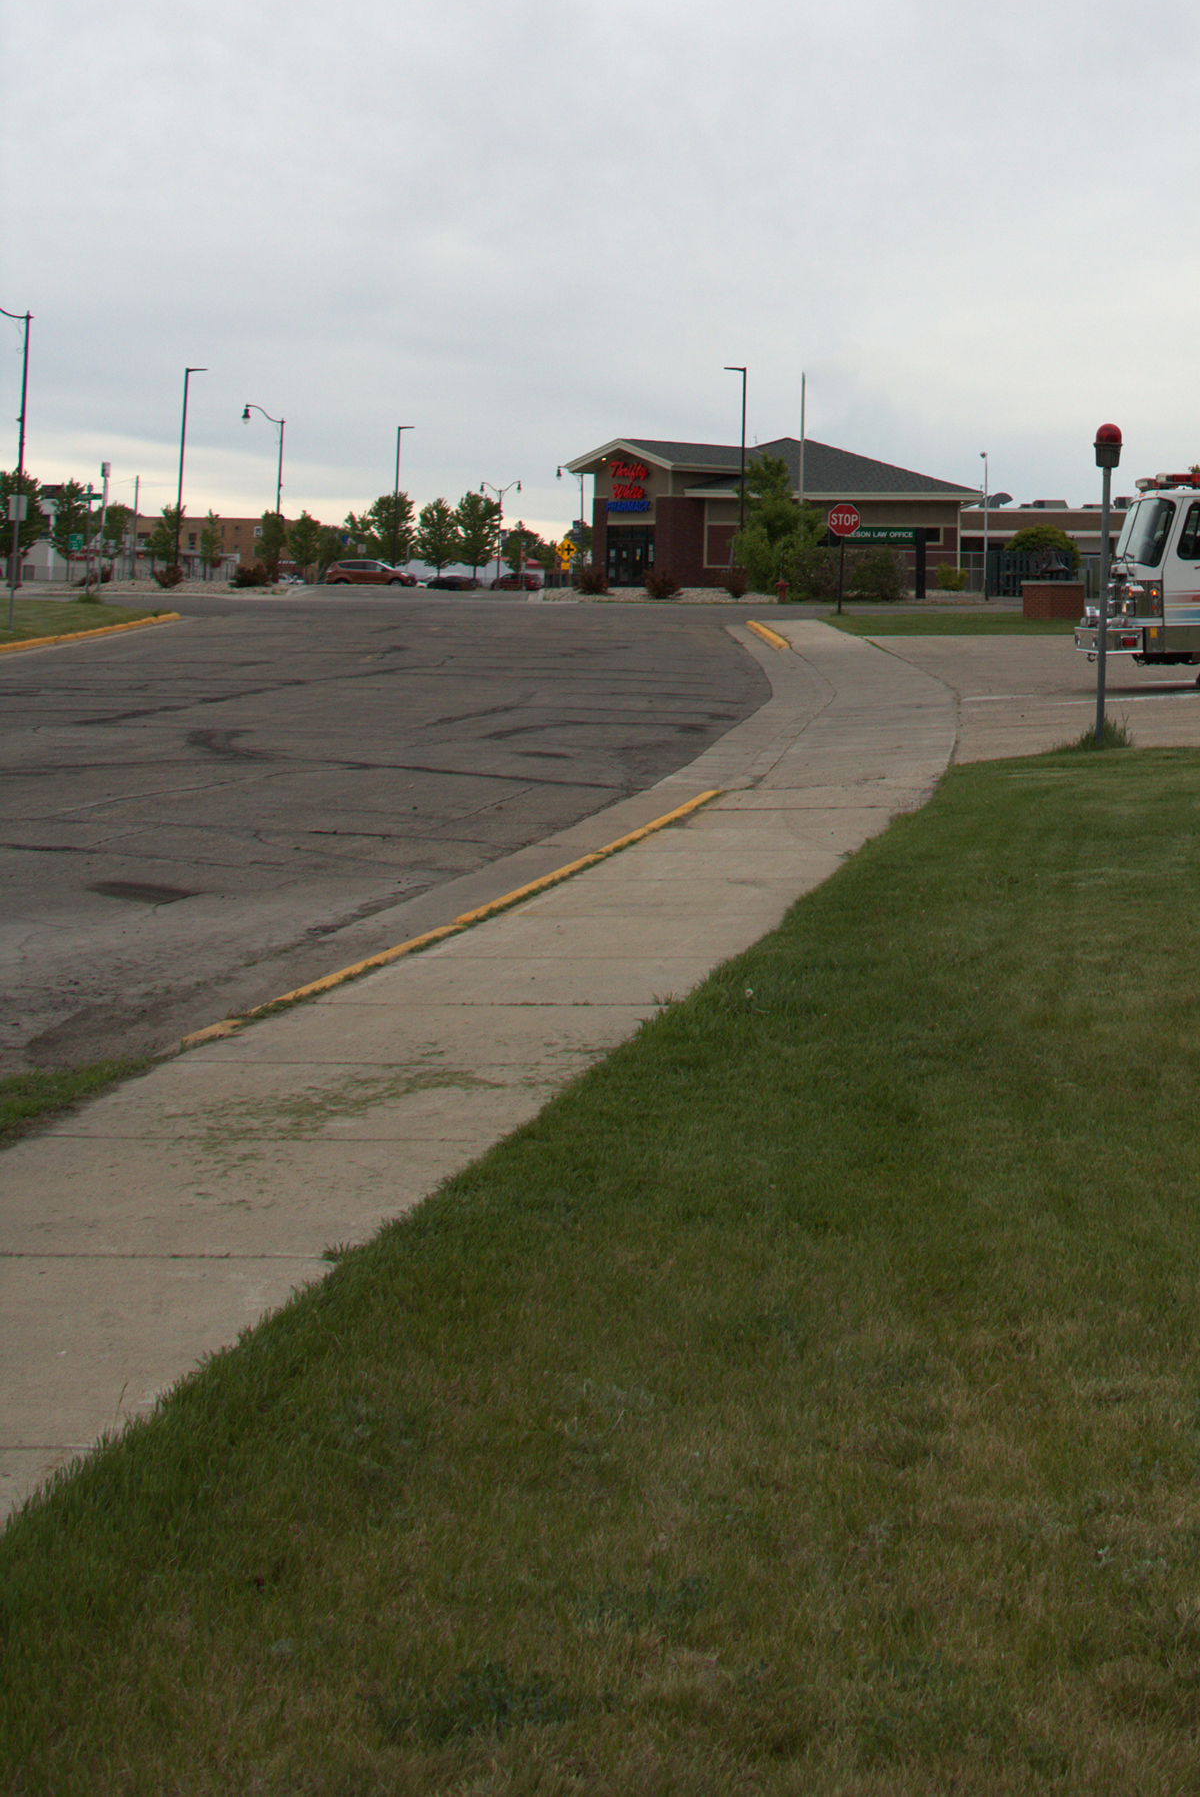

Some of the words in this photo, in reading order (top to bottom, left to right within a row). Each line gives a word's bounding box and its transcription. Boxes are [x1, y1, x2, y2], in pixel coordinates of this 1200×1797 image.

[609, 461, 649, 482] Thrifty
[611, 483, 645, 499] White
[605, 500, 650, 512] PHARMACY
[830, 513, 858, 526] STOP
